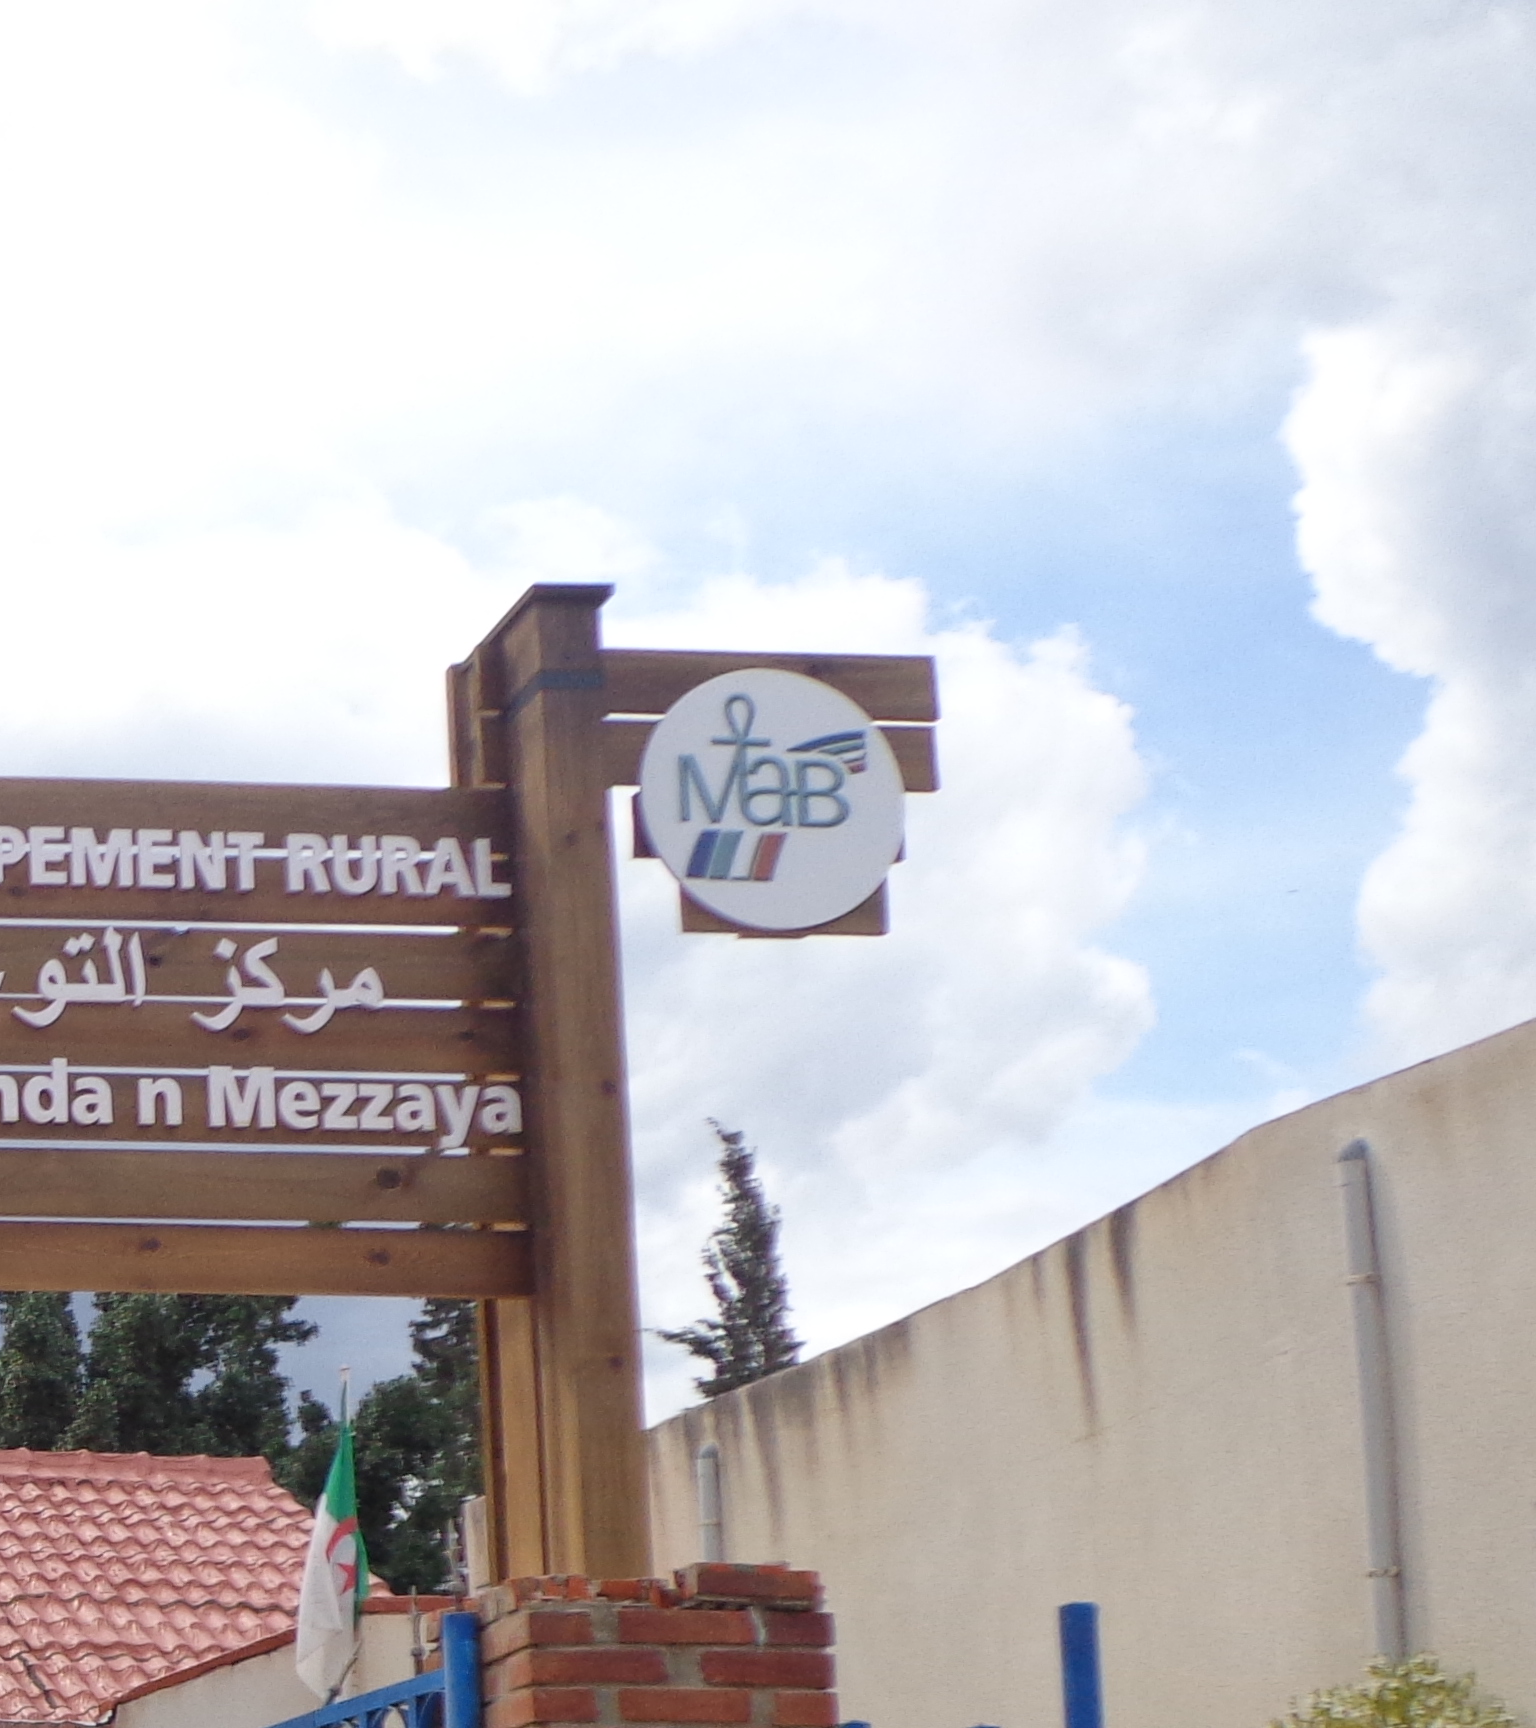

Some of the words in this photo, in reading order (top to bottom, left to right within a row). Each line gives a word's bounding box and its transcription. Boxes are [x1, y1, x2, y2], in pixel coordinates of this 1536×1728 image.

[284, 831, 512, 899] RURAL
[190, 937, 386, 1035] مركز
[136, 1074, 184, 1127] n
[206, 1064, 524, 1149] Mezzaya
